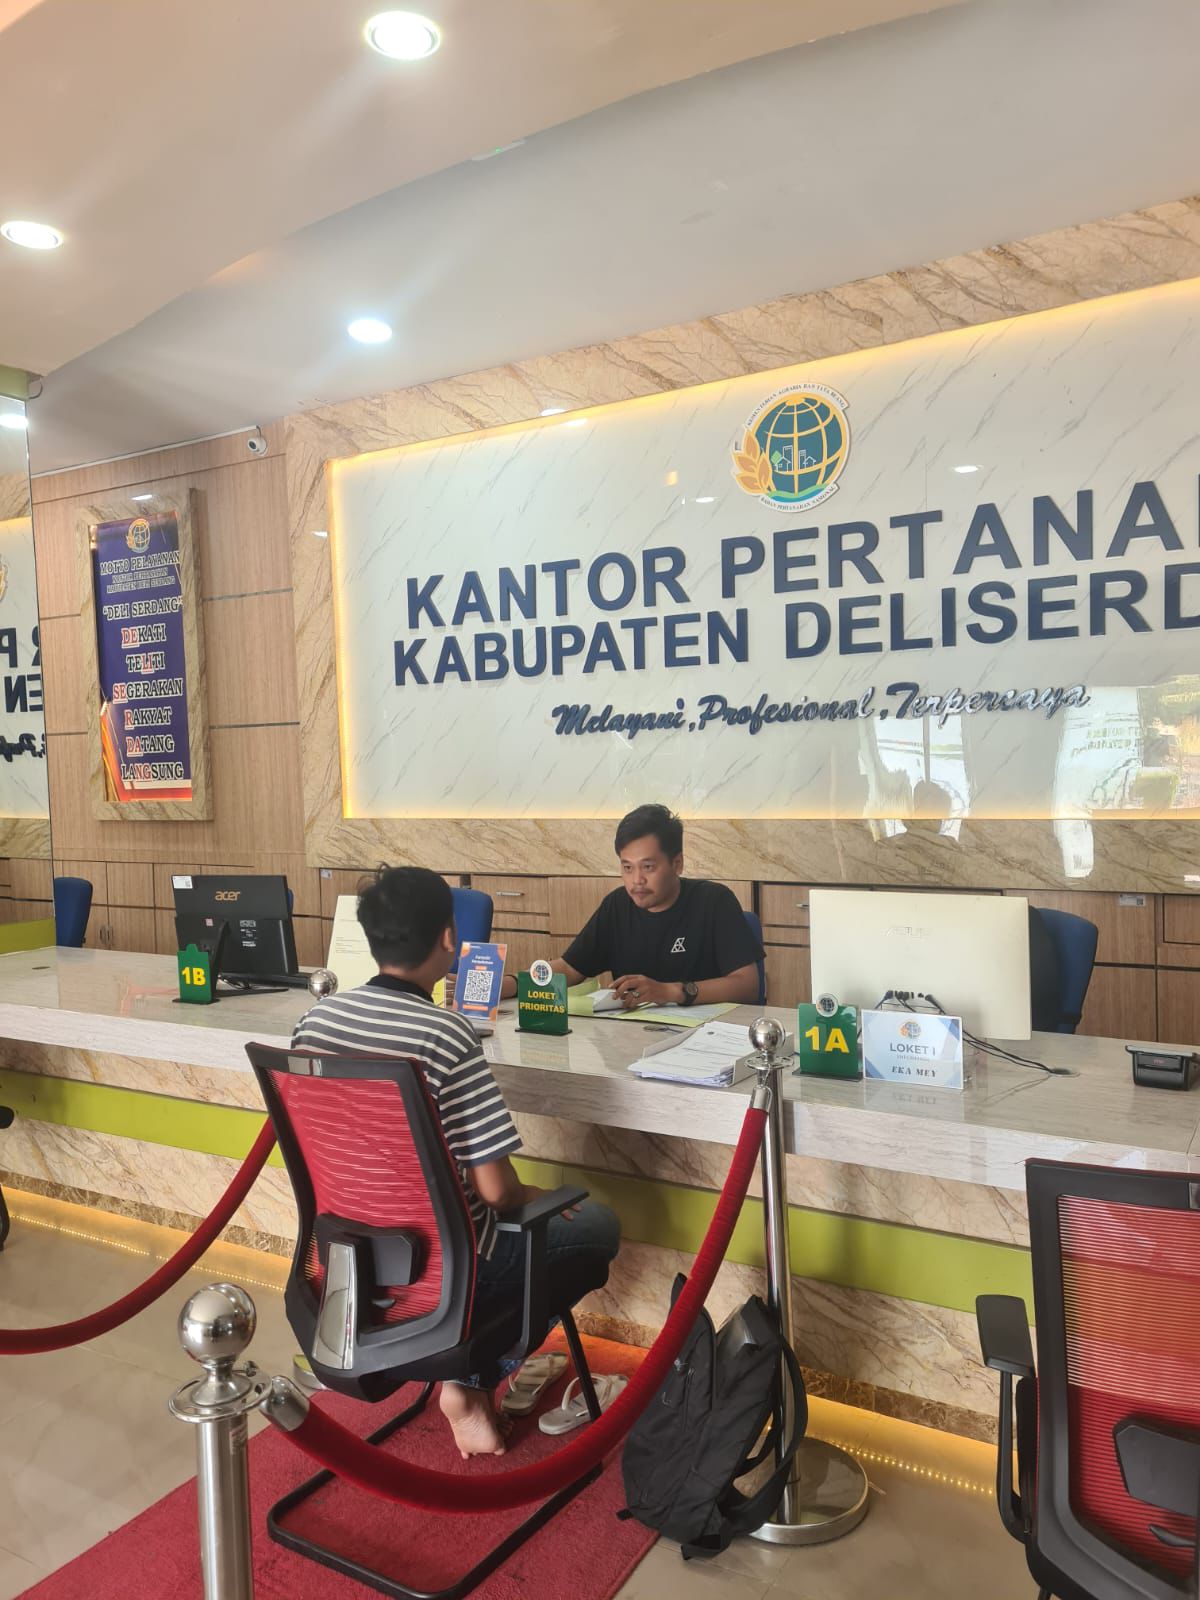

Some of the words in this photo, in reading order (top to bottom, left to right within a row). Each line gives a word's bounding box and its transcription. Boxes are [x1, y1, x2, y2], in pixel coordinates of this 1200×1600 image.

[407, 546, 691, 629] KANTOR
[721, 474, 1200, 599] PERTANA
[100, 558, 130, 576] MOTTO
[121, 623, 167, 647] DEKATI
[393, 607, 749, 686] KABUPATEN
[126, 651, 166, 673] TELITI
[112, 678, 183, 703] SEGERAKAN
[124, 706, 172, 729] RAKYAT
[126, 734, 175, 756] DATANG
[121, 762, 184, 781] LANGSUNG
[215, 890, 241, 901] acer
[182, 966, 206, 986] 1B
[527, 990, 556, 1001] LOKET
[519, 1002, 565, 1014] PRIORITAS
[805, 1026, 849, 1054] 1A
[889, 1042, 929, 1055] LOKET
[891, 1065, 912, 1075] EKA
[916, 1068, 938, 1078] MEY
